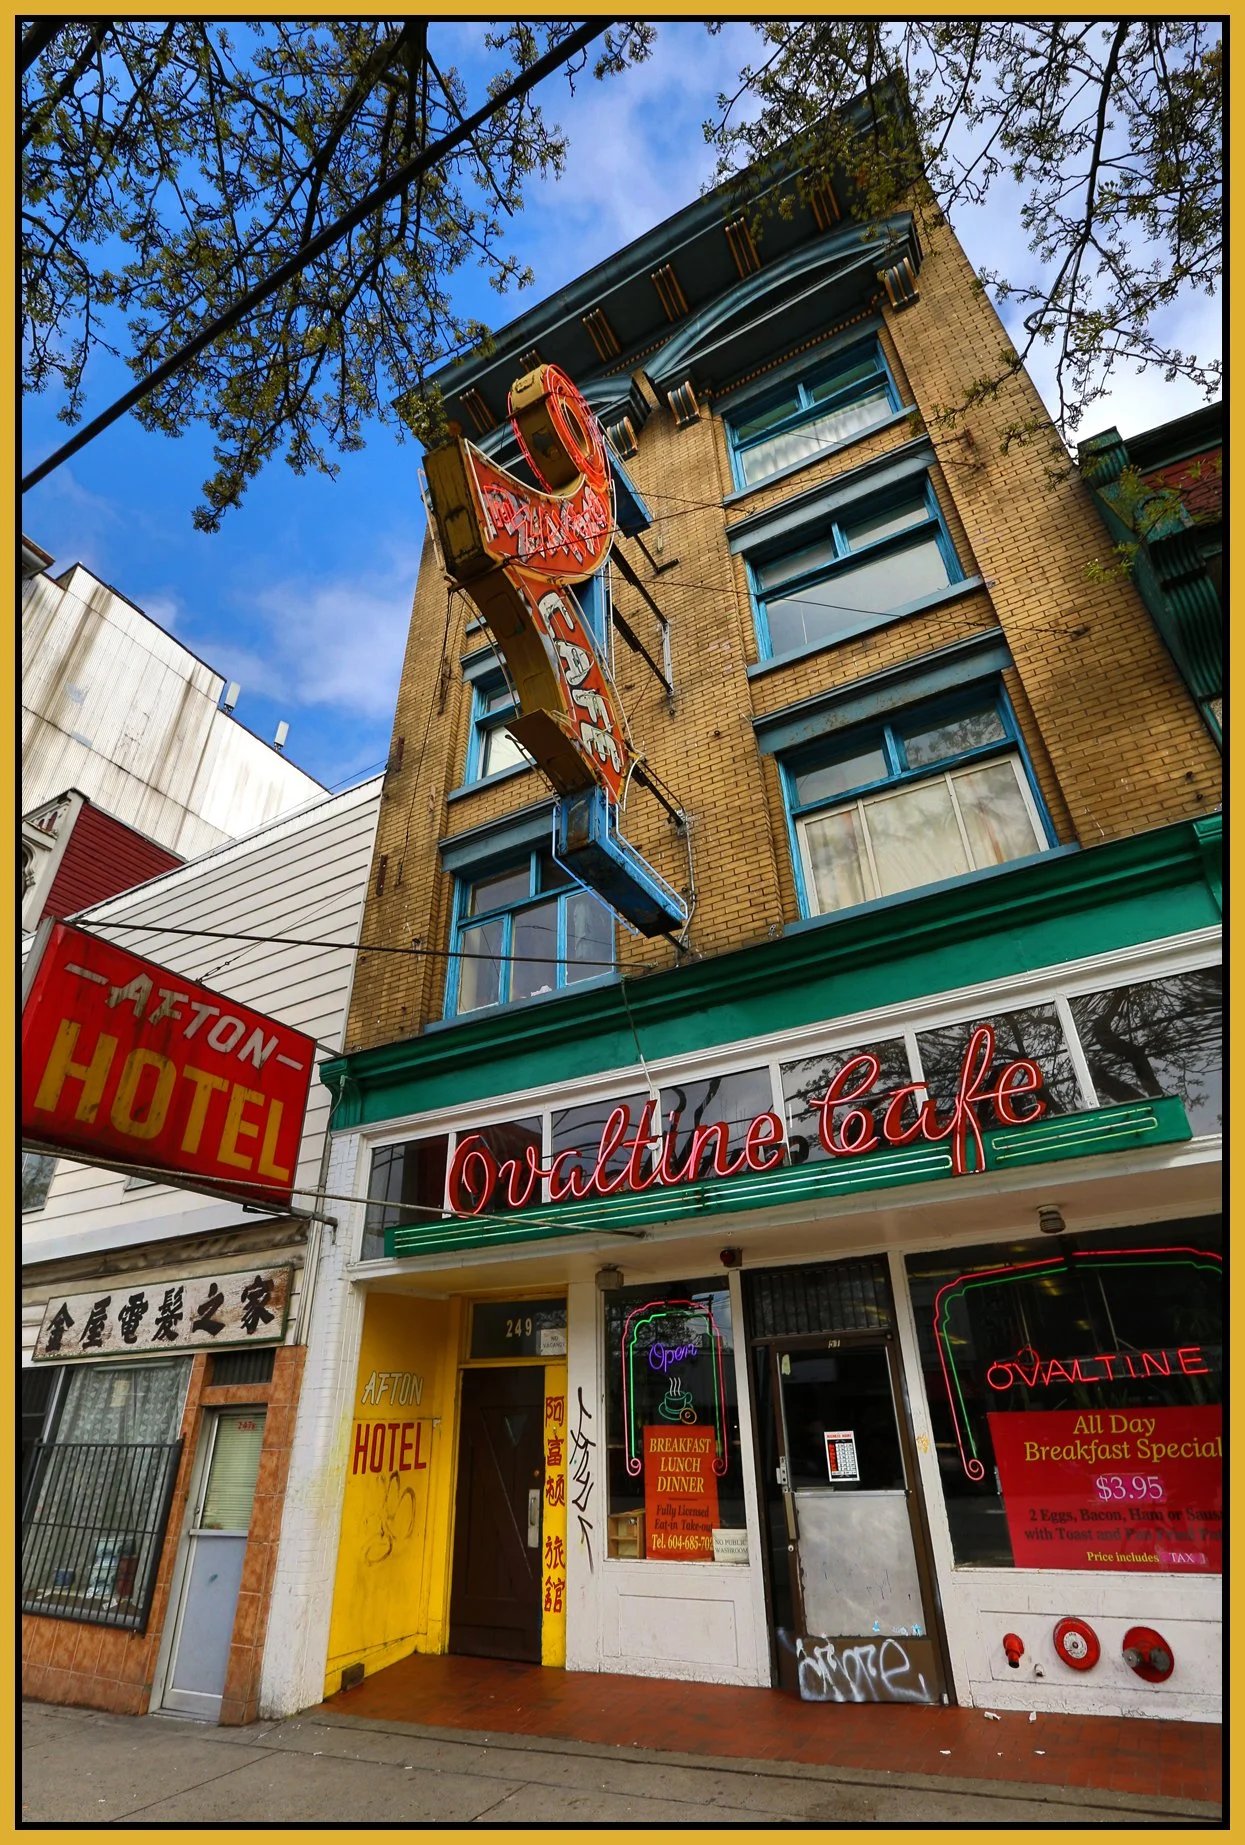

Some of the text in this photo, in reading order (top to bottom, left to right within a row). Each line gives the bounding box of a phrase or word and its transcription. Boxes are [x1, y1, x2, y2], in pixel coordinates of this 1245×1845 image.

[538, 590, 621, 775] CAFE
[105, 972, 279, 1070] AFTON
[33, 1018, 290, 1182] HOTEL
[447, 1024, 1046, 1218] Ovaltine Cafe
[505, 1318, 532, 1338] 249
[648, 1342, 697, 1373] Open
[986, 1347, 1209, 1390] OVALTINE
[361, 1371, 424, 1407] AFTON
[1073, 1414, 1155, 1436] All Day
[352, 1422, 427, 1475] HOTEL
[649, 1437, 712, 1454] BREAKFAST
[1024, 1437, 1222, 1463] Breakfast Special
[660, 1456, 701, 1473] LUNCH
[656, 1475, 705, 1494] DINNER
[1096, 1475, 1163, 1502] $3.95
[656, 1504, 710, 1518] Fully Licensed
[1029, 1507, 1222, 1524] 2 Eggs, Bacon, Ham or Saus
[655, 1519, 678, 1530] Eat-in
[1025, 1527, 1053, 1541] with
[1055, 1527, 1092, 1541] Toast
[1097, 1527, 1123, 1541] and
[652, 1533, 713, 1551] Tel. 604-685-702
[715, 1538, 724, 1546] NO
[1086, 1551, 1196, 1563] Price includes TAX
